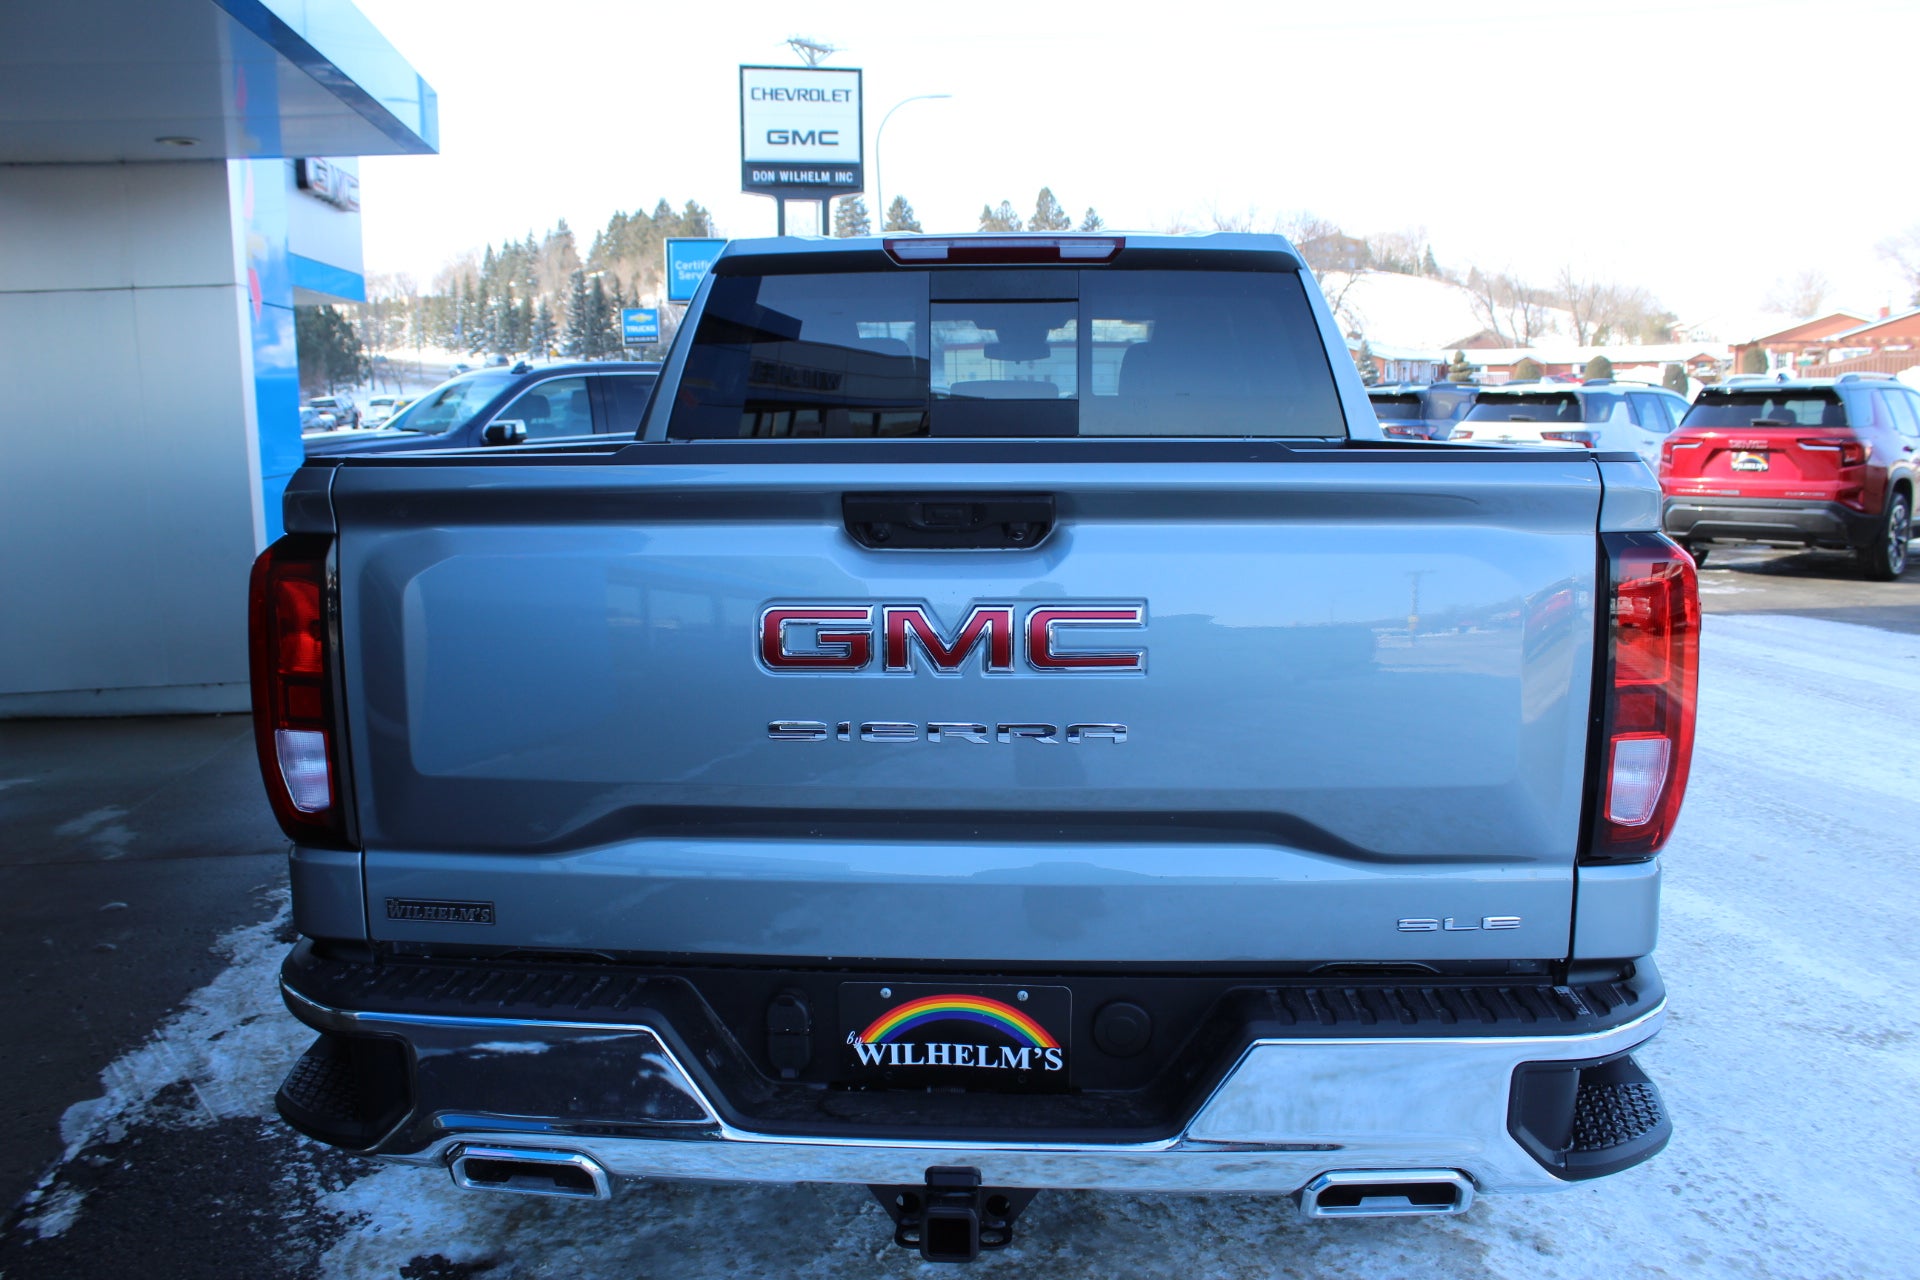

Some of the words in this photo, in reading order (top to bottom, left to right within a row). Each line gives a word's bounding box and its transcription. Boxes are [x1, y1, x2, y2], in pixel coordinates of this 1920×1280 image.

[751, 87, 852, 102] CHEVROLET
[767, 129, 839, 145] GMC
[752, 170, 775, 182] DON
[779, 170, 830, 183] WILHELM
[835, 171, 853, 183] INC
[678, 270, 703, 281] Serv
[759, 603, 1144, 673] GMC
[767, 720, 1128, 744] SIERRA
[387, 905, 490, 921] WILHELM'S
[1397, 916, 1521, 932] SLE
[846, 1030, 864, 1048] by
[853, 1042, 1064, 1071] WILHELM'S
